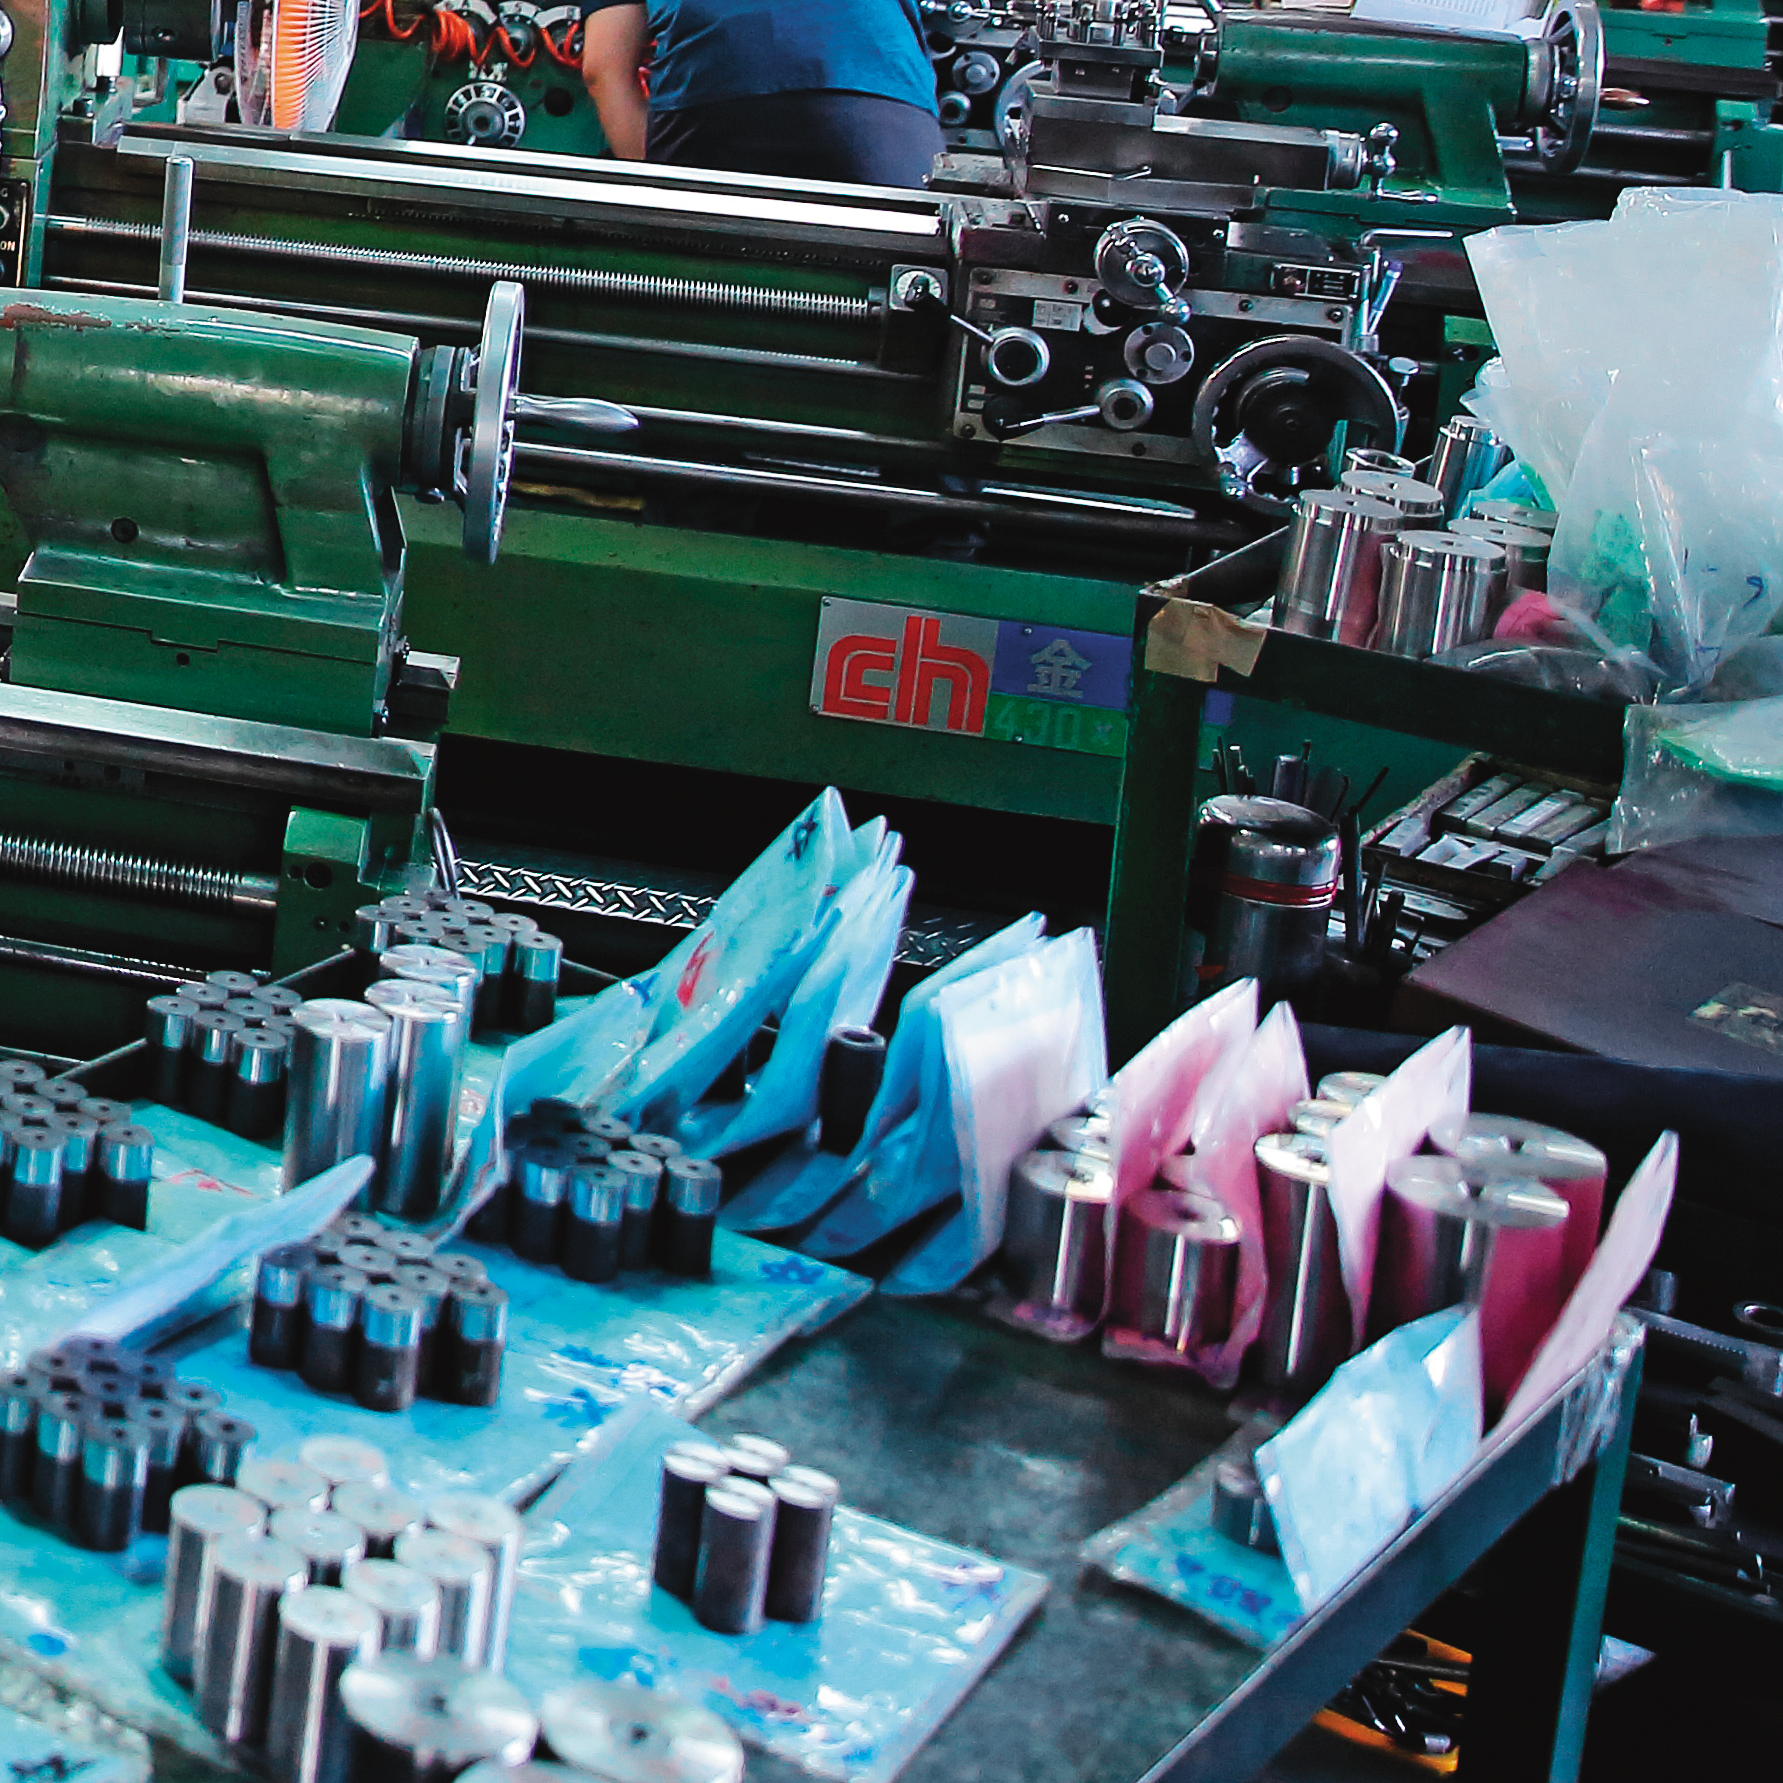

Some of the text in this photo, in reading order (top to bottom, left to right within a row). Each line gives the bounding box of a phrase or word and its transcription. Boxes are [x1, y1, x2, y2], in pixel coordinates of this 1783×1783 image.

[0, 240, 16, 252] ON
[822, 615, 991, 734] ch
[1027, 638, 1091, 699] 金
